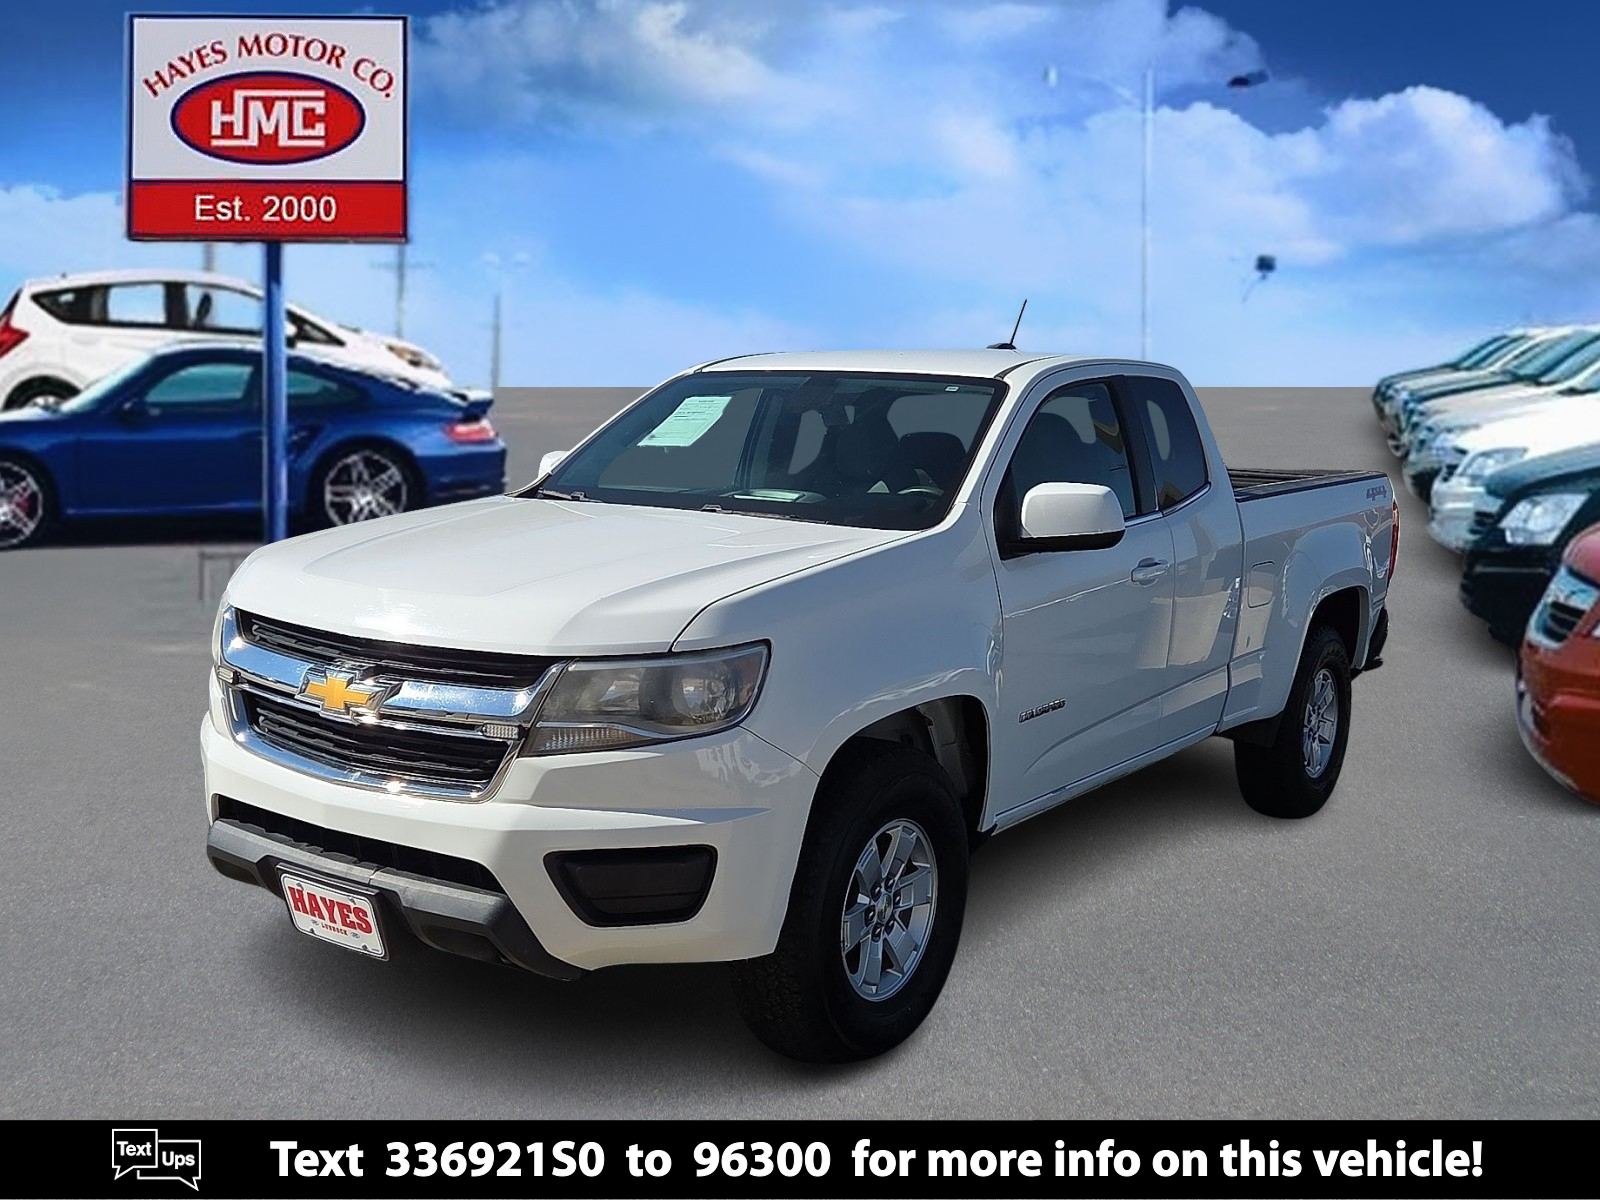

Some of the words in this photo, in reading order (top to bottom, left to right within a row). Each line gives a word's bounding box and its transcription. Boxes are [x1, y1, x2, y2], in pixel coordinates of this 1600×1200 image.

[142, 40, 228, 97] HAYES
[237, 33, 347, 70] MOTOR
[352, 57, 395, 98] CO.
[210, 89, 326, 147] HMC
[194, 195, 250, 222] Est.
[262, 195, 337, 222] 2000
[287, 885, 373, 934] HAYES
